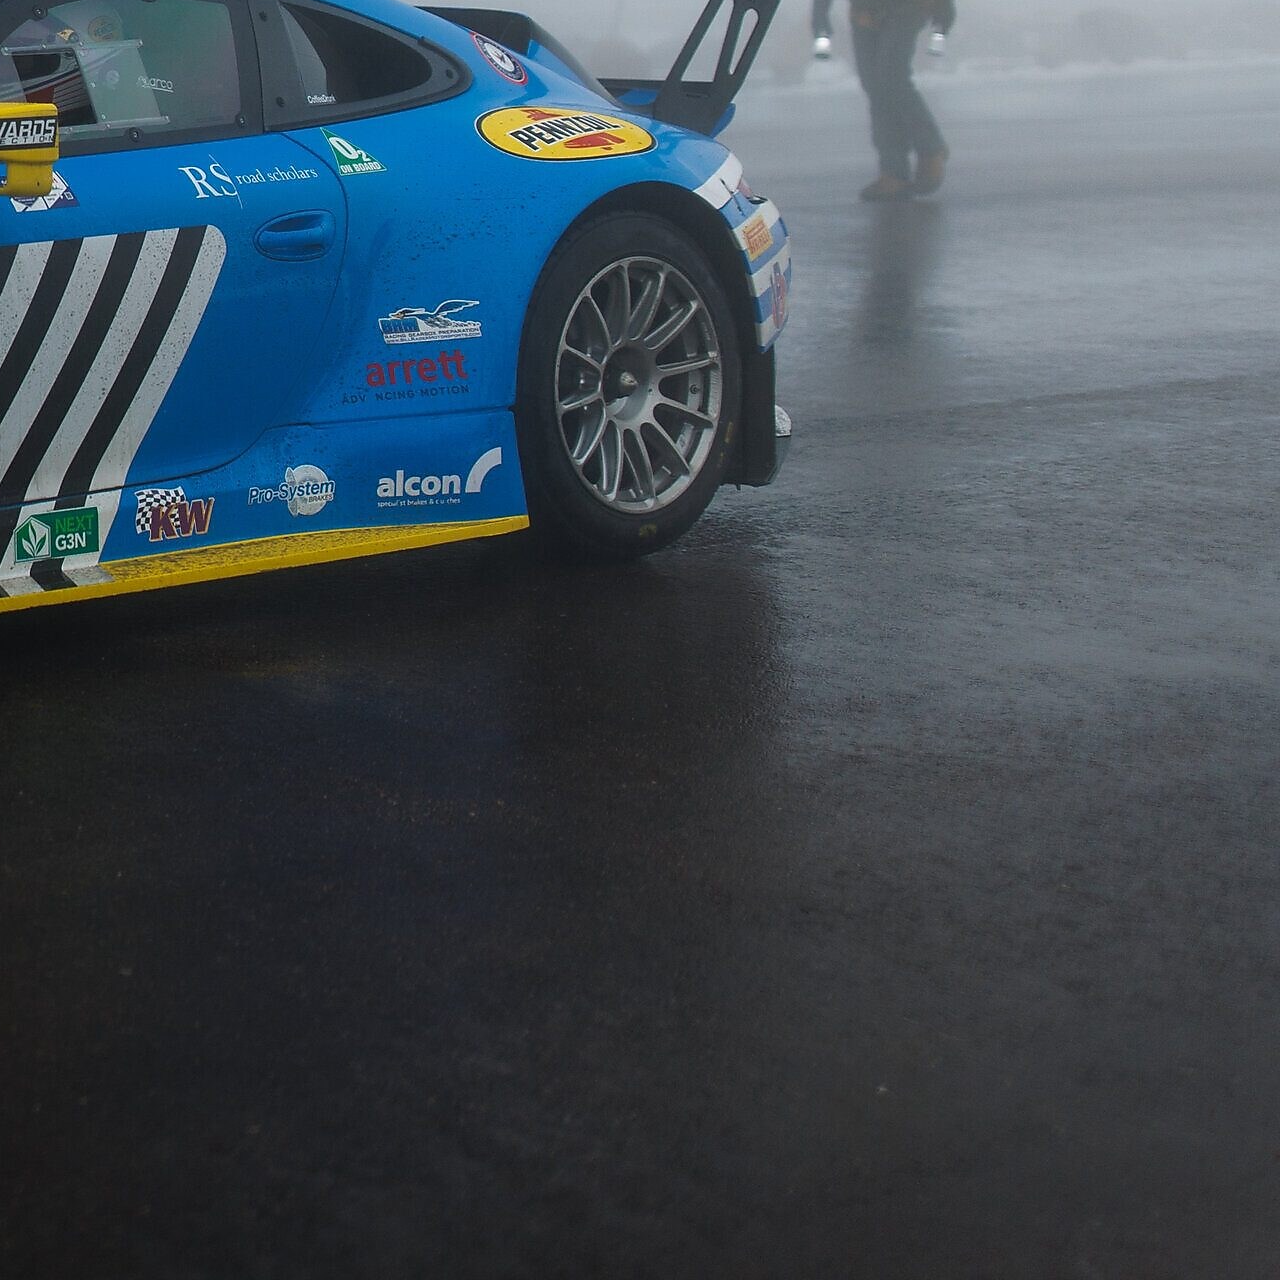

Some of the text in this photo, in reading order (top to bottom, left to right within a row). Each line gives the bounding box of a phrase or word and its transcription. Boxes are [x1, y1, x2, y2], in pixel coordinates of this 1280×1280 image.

[507, 115, 622, 152] PENNZOIL
[236, 168, 265, 185] road
[266, 165, 319, 183] scholars
[340, 162, 382, 173] ON BOARD
[342, 384, 470, 405] ADVNCING MOTION
[248, 480, 336, 505] Pro-System
[376, 469, 461, 498] alcon
[308, 494, 334, 503] BRAKES
[55, 513, 95, 533] NEXT
[149, 497, 215, 542] KW
[55, 531, 87, 552] G3N
